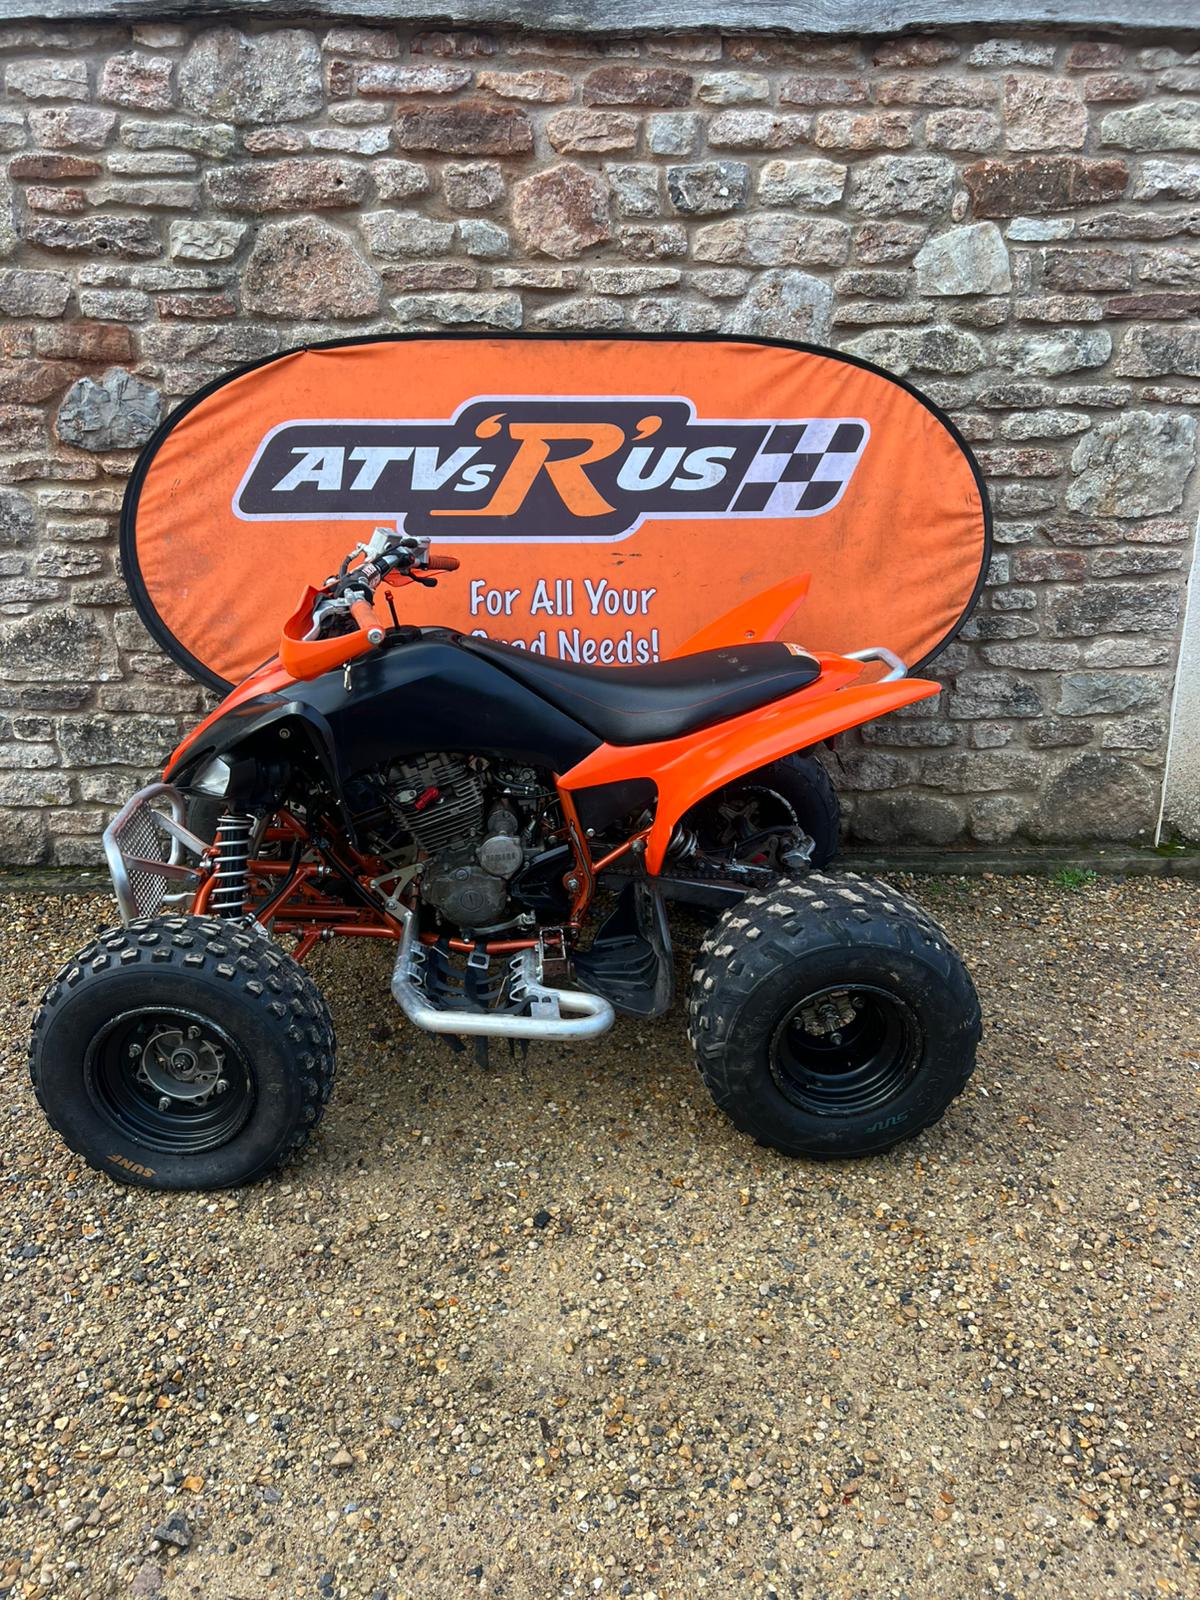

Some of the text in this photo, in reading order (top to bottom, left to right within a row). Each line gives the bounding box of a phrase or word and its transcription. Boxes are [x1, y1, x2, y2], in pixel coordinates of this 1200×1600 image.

[271, 446, 497, 492] ATVs
[470, 578, 657, 616] For All Your
[557, 628, 660, 664] Needs!
